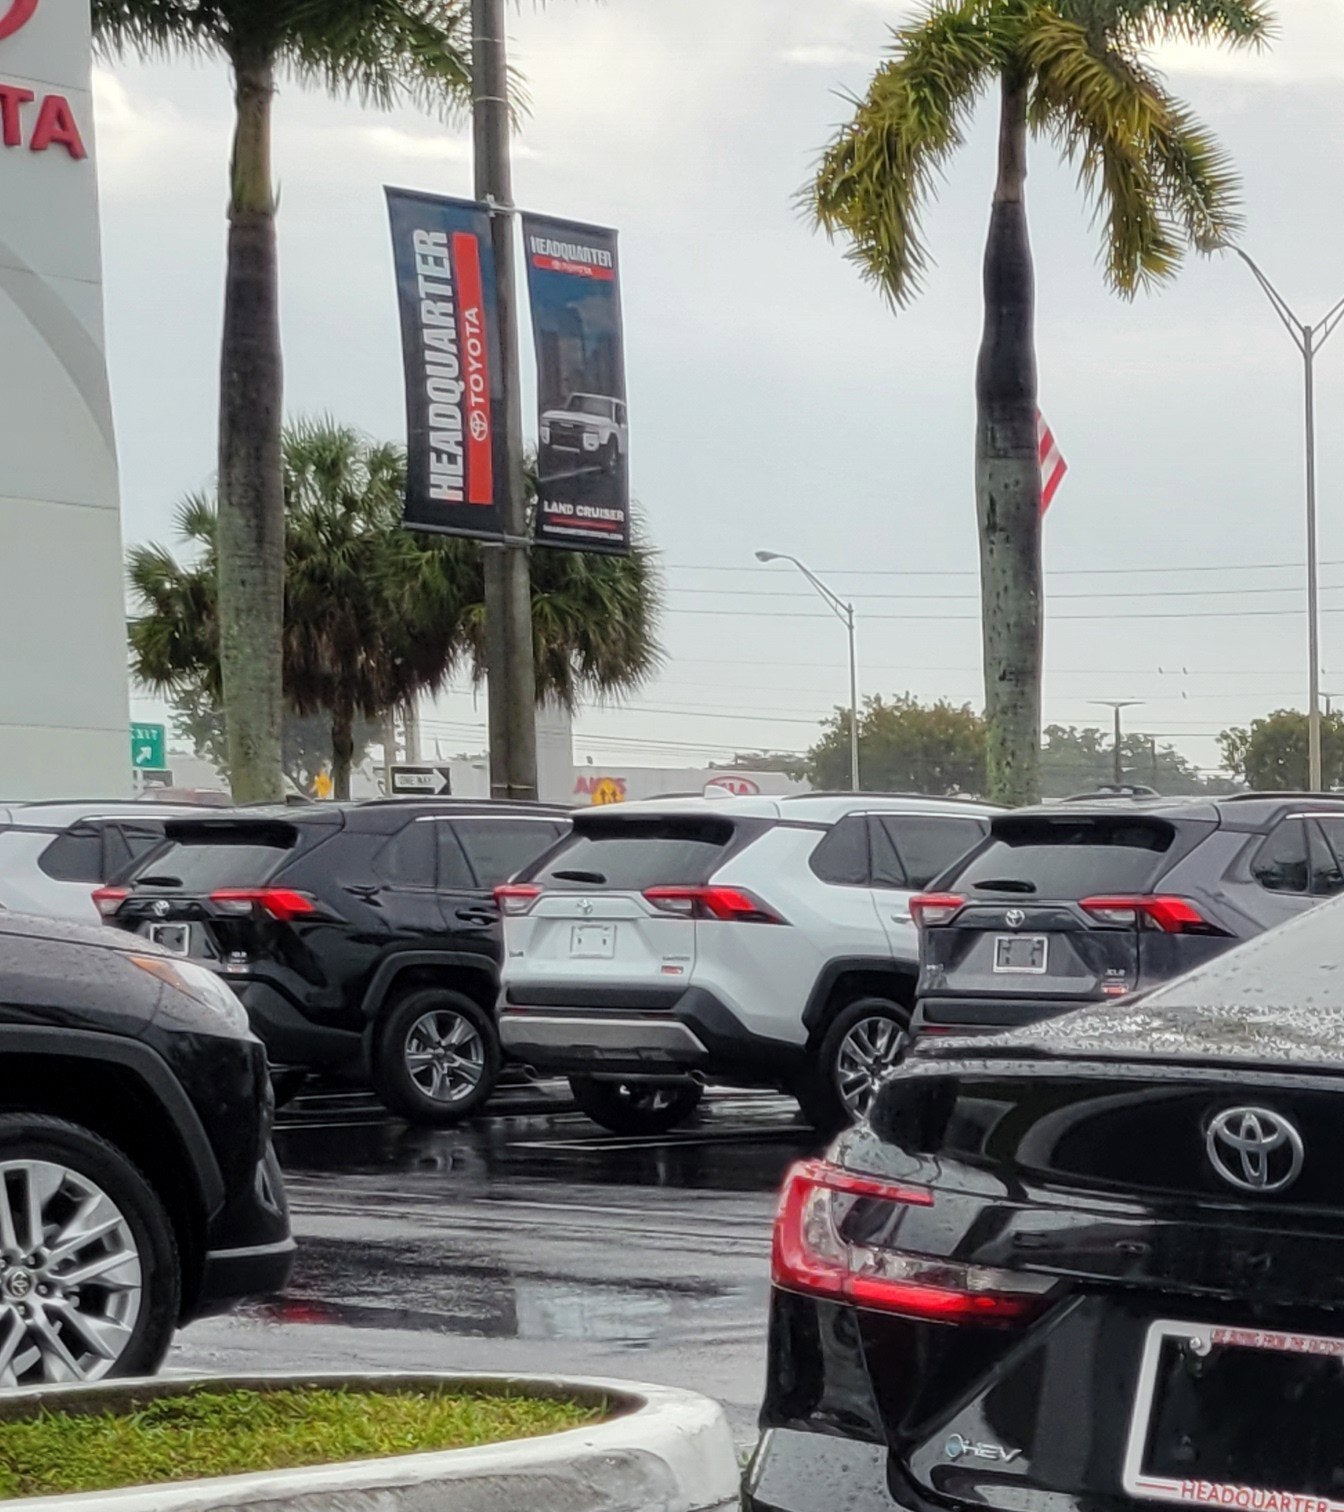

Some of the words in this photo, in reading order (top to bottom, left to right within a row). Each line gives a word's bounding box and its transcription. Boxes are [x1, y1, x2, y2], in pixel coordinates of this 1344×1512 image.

[530, 235, 613, 268] HEADQUARTER
[413, 228, 465, 502] HEADQUARTER
[464, 307, 485, 407] TOYOTA
[543, 500, 574, 515] LAND
[575, 504, 625, 522] CRUISER
